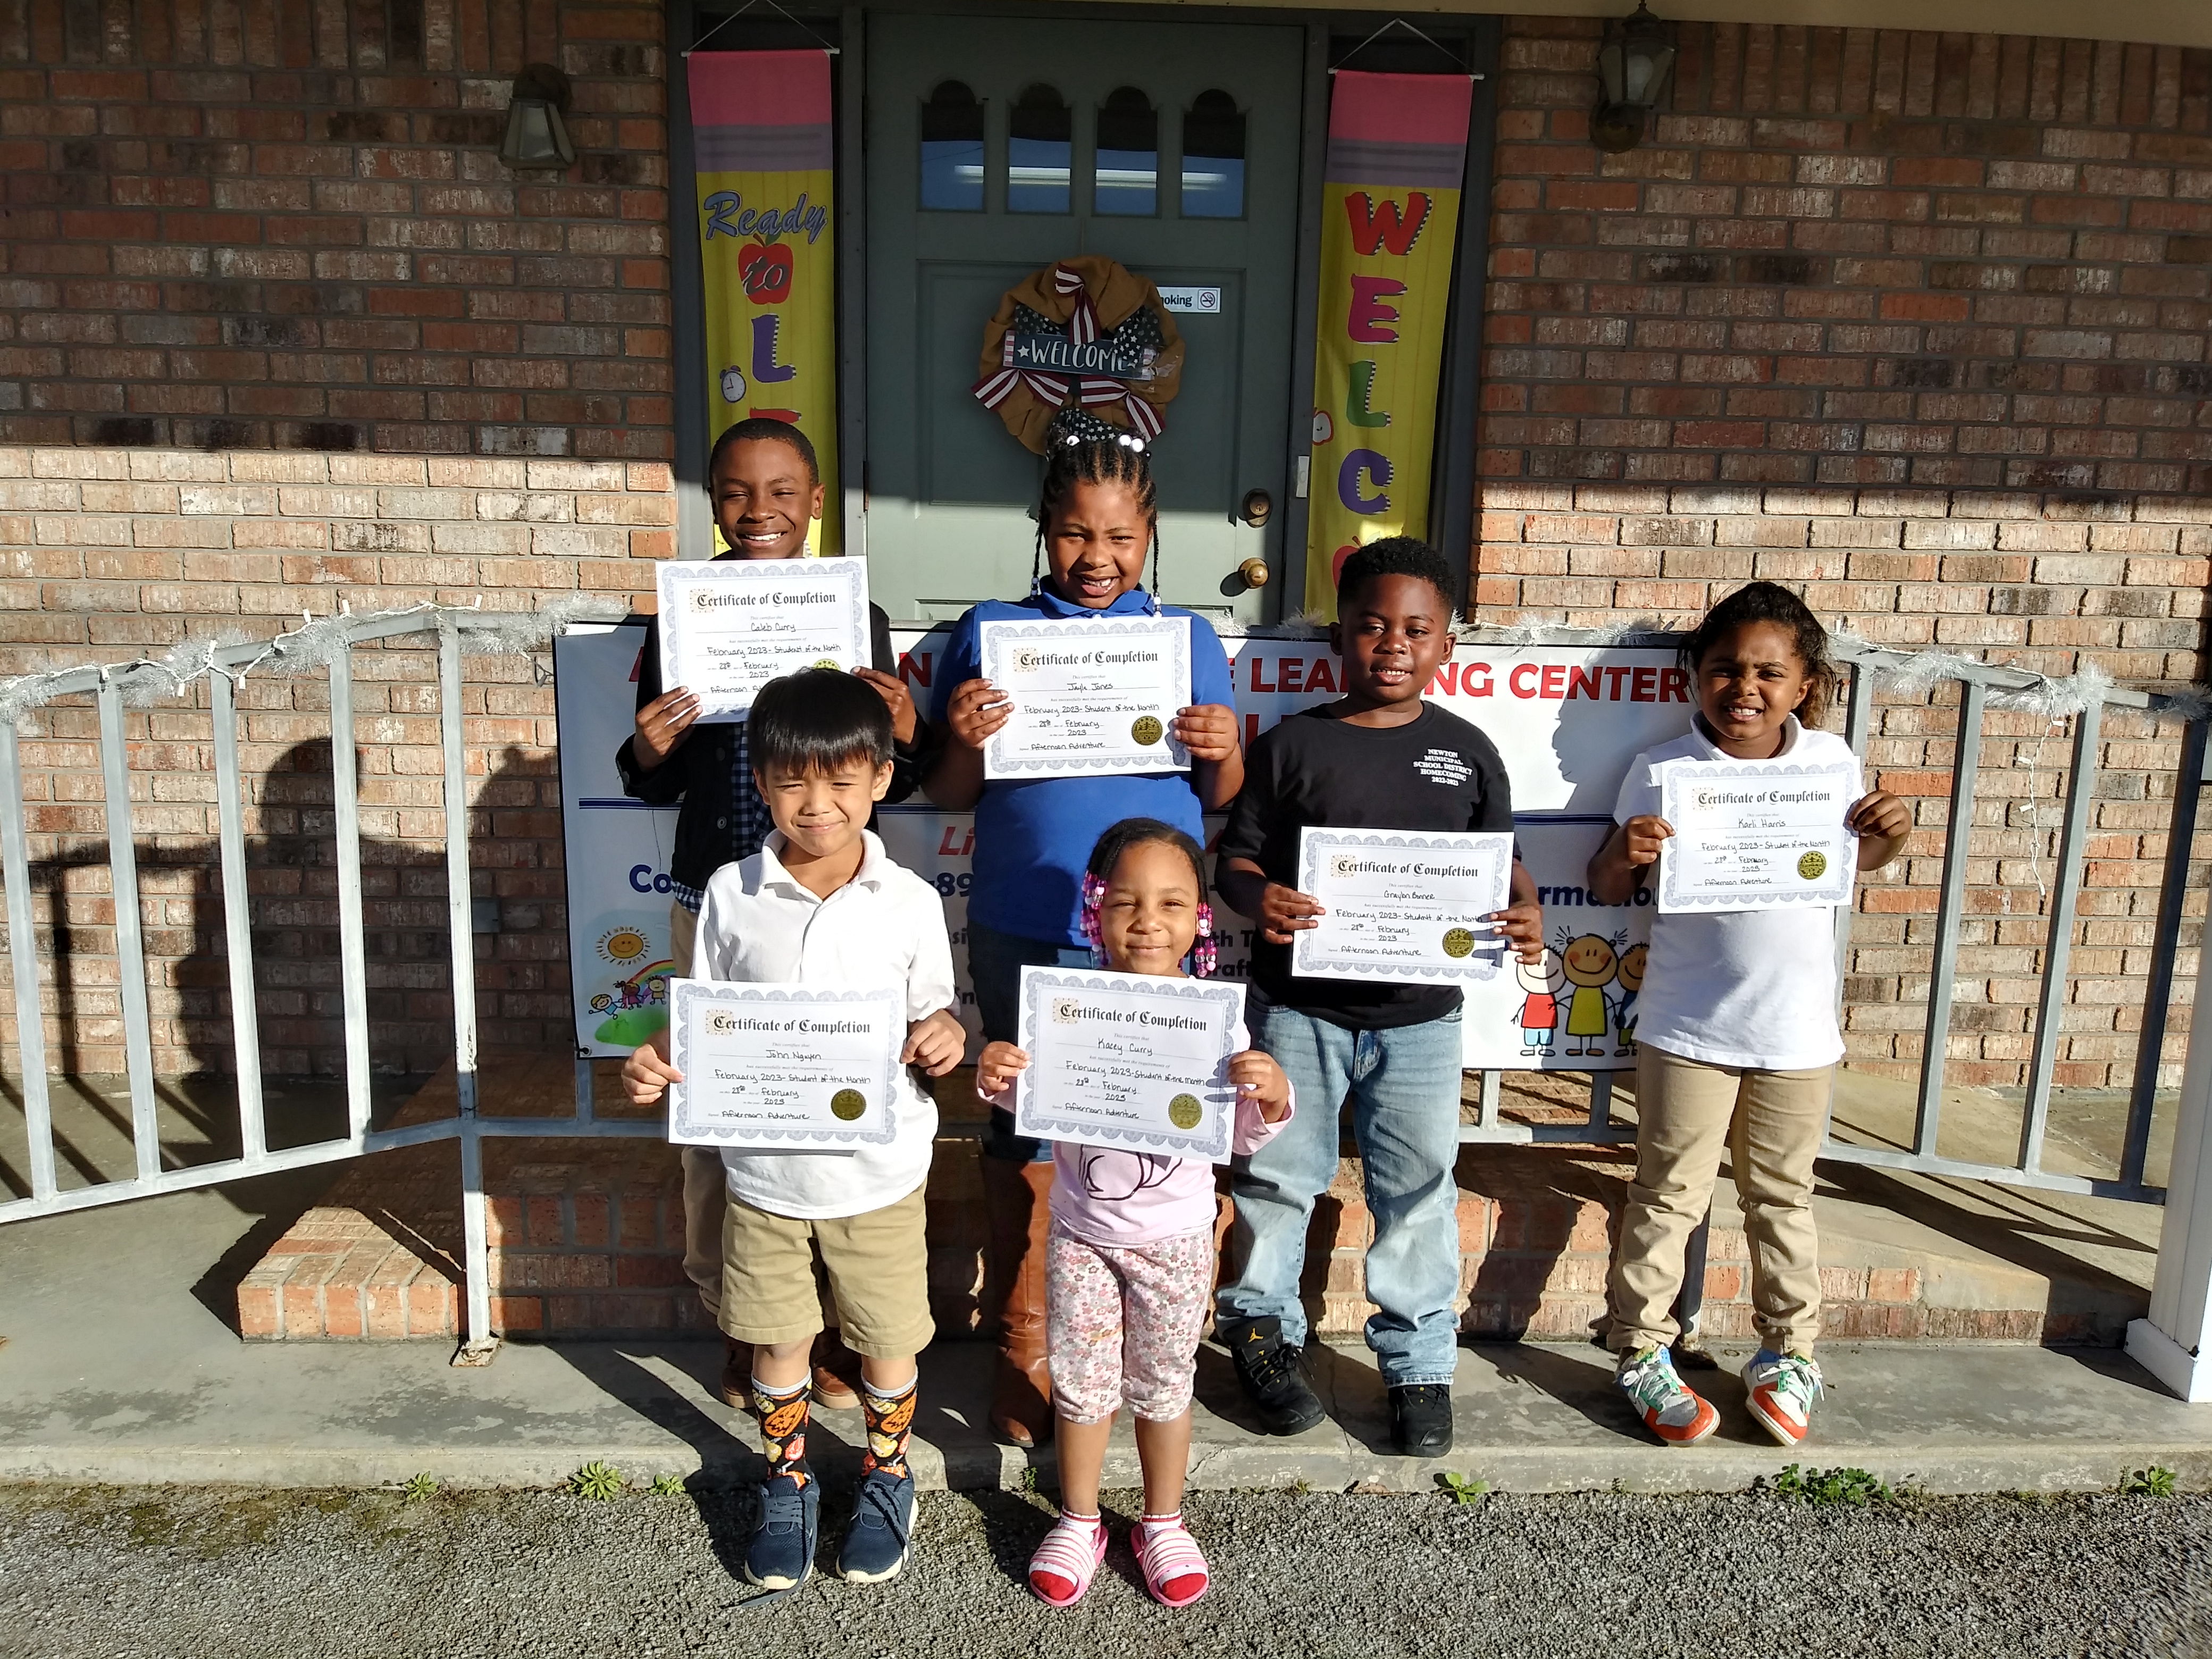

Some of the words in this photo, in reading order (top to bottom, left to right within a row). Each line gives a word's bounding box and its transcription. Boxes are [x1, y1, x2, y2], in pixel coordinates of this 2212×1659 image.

[703, 190, 828, 245] Ready
[743, 255, 789, 296] to
[1338, 191, 1432, 515] WELC
[697, 594, 756, 609] Certificate
[759, 593, 769, 605] of
[773, 592, 836, 607] Completion
[751, 623, 772, 631] Caleb
[775, 623, 796, 632] Curry
[707, 647, 745, 658] February
[1020, 653, 1078, 668] Certificate
[1082, 652, 1092, 664] of
[1095, 650, 1158, 666] Completion
[1509, 663, 1689, 703] CENTER
[1024, 705, 1060, 717] February
[1066, 719, 1100, 728] February
[1423, 755, 1463, 765] MUNICIPAL
[1427, 749, 1458, 758] NEWTON
[1420, 768, 1467, 782] HOMECOMING
[1444, 763, 1473, 776] DISTRICT
[1698, 793, 1753, 807] Certificate
[1757, 792, 1767, 803] of
[1769, 791, 1830, 805] Completion
[1738, 818, 1756, 828] Karli
[1761, 818, 1786, 827] Harris
[1702, 843, 1737, 854] February
[1738, 856, 1769, 865] February
[1338, 860, 1397, 874] Certificate
[1400, 863, 1412, 874] of
[1413, 863, 1478, 878] Completion
[1384, 890, 1410, 902] Graylon
[1336, 909, 1376, 922] February
[1378, 925, 1410, 936] February
[1341, 945, 1379, 954] Afternoon
[1060, 1004, 1122, 1021] Certificate
[1126, 1011, 1137, 1023] of
[1139, 1011, 1206, 1031] Completion
[714, 1016, 780, 1032] Certificate
[784, 1019, 797, 1032] of
[799, 1019, 870, 1035] Completion
[1098, 1037, 1122, 1055] Kacey
[1129, 1043, 1153, 1057] Curry
[766, 1049, 789, 1059] John
[792, 1051, 822, 1062] Nguyen
[1066, 1060, 1107, 1077] February
[715, 1069, 758, 1084] February
[788, 1074, 817, 1082] Student
[821, 1074, 828, 1083] of
[761, 1087, 799, 1099] February
[1102, 1080, 1137, 1095] February
[722, 1110, 763, 1118] Afternoon
[1065, 1102, 1102, 1115] Afternoon
[1105, 1108, 1139, 1119] Adventure
